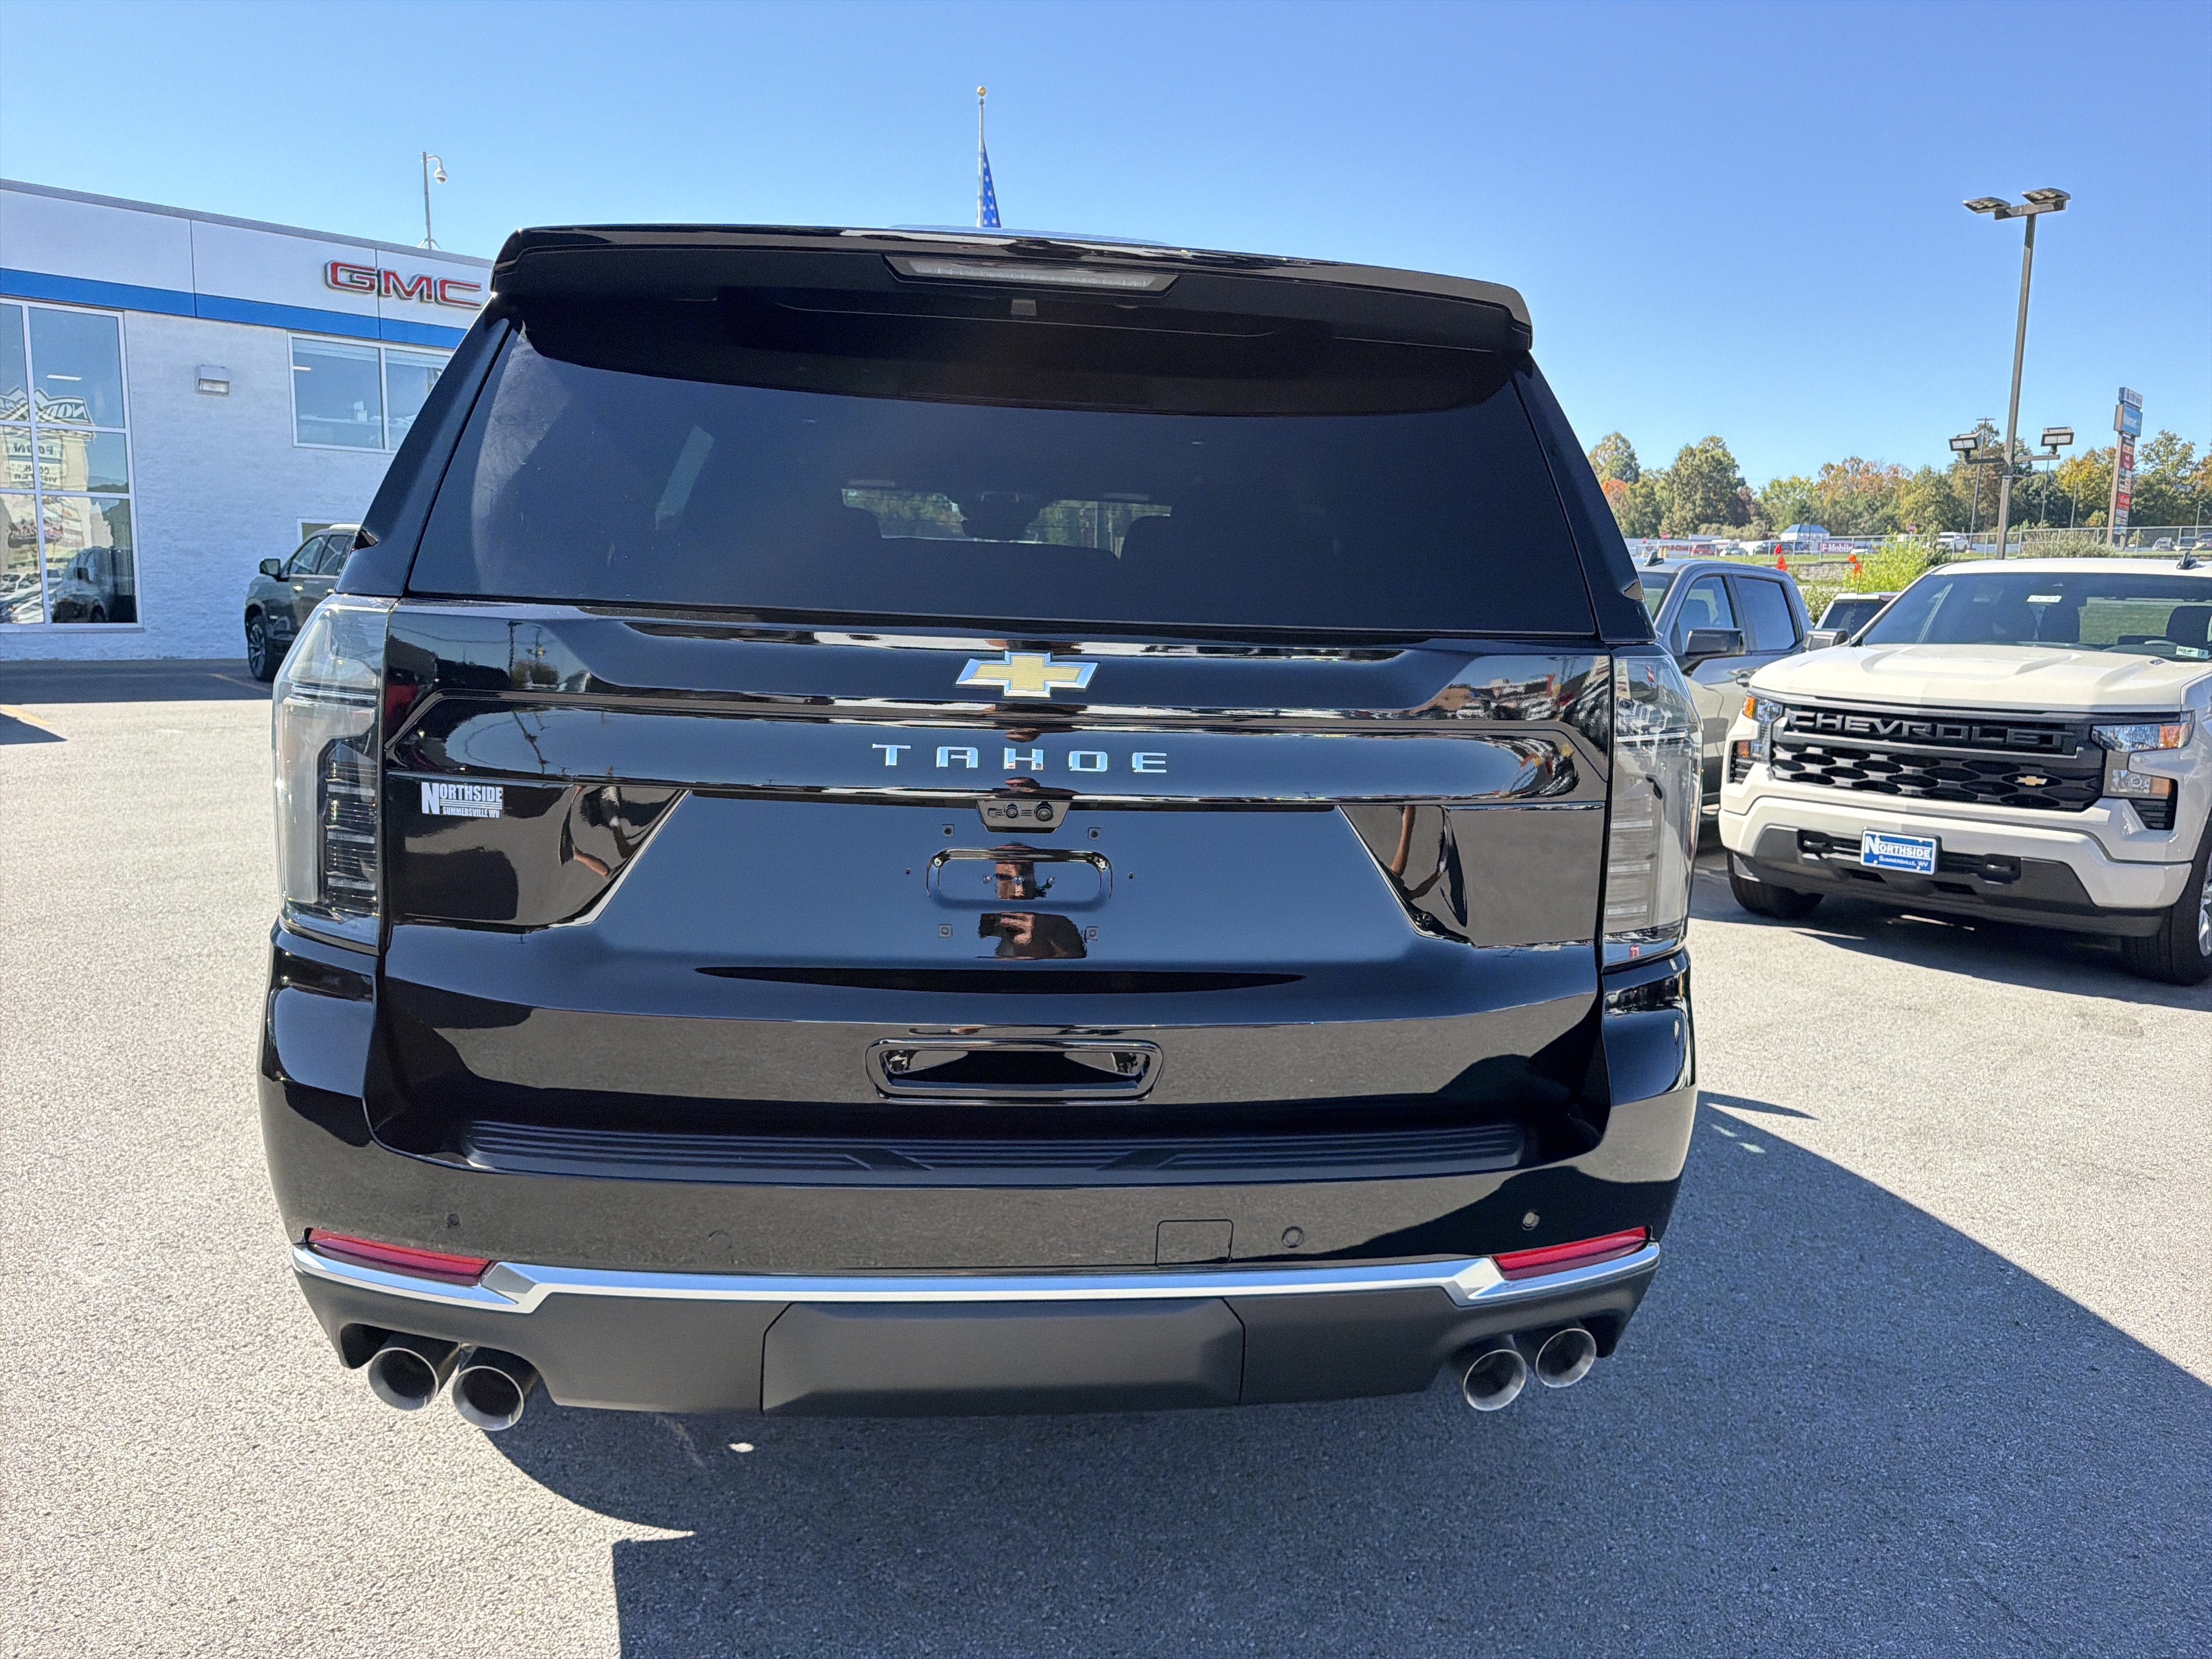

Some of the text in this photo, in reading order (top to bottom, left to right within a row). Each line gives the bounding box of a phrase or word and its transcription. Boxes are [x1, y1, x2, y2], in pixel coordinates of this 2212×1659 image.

[327, 260, 482, 309] GMC
[1788, 711, 2075, 746] CHEVROLET
[872, 743, 1167, 772] TAHOE
[421, 782, 503, 814] NORTHSIDE
[442, 806, 500, 818] SUMMERSVILLE WV
[1865, 836, 1931, 858] NORTHSIDE
